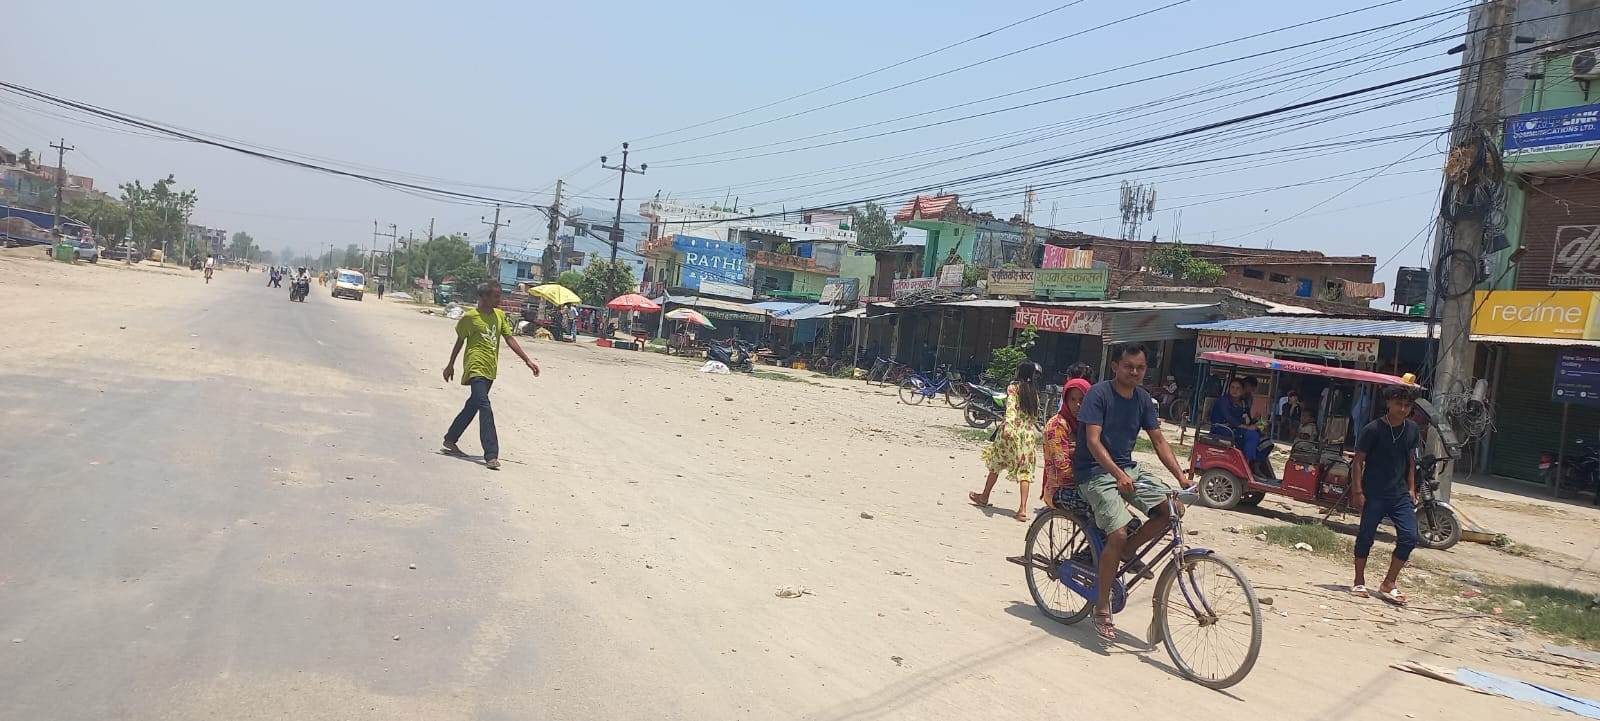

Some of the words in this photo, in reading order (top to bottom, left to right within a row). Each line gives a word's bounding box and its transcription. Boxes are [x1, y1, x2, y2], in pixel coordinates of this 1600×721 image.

[1580, 123, 1596, 132] LTD.
[686, 252, 743, 271] RATHI
[1491, 302, 1582, 323] realme
[1278, 335, 1320, 350] राजमार्ग
[1357, 340, 1376, 353] घर
